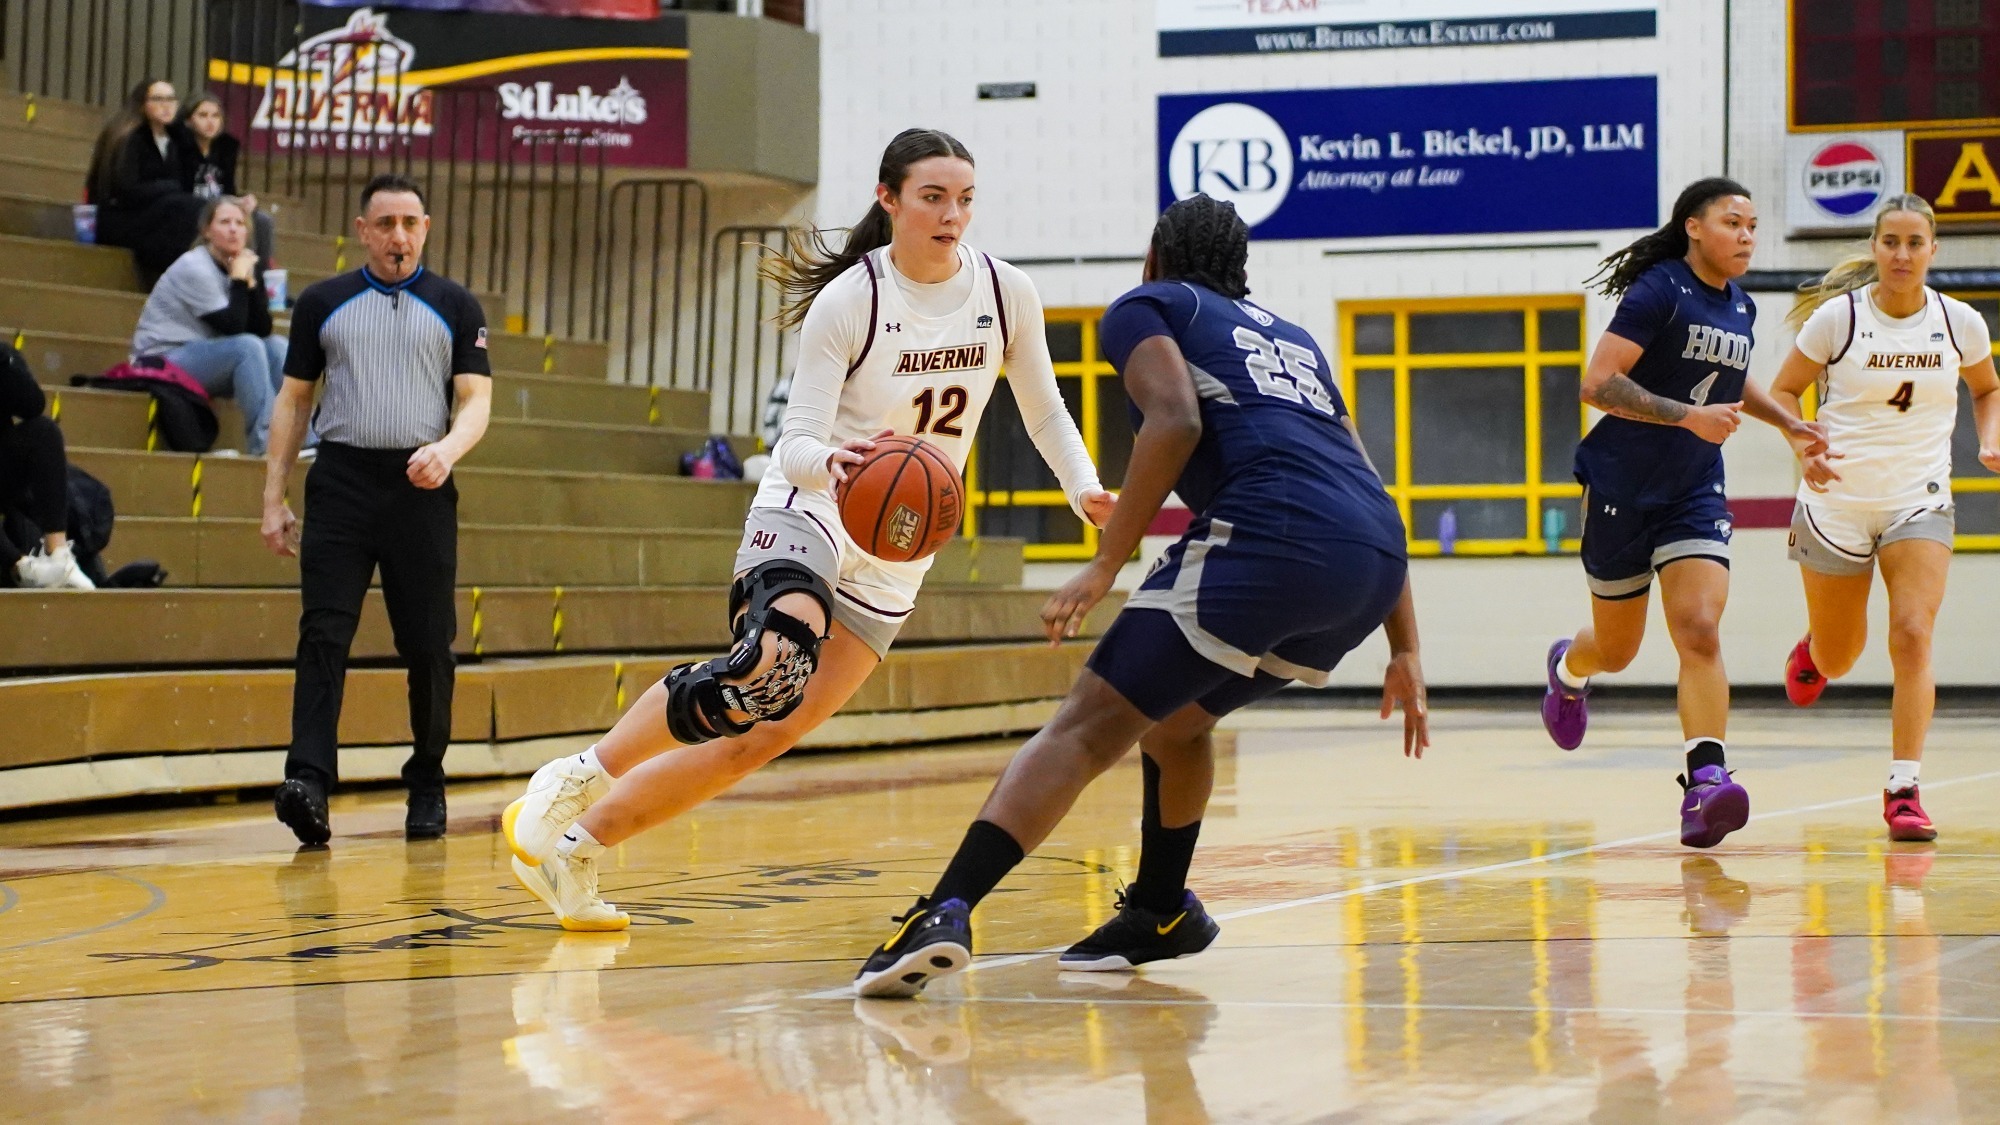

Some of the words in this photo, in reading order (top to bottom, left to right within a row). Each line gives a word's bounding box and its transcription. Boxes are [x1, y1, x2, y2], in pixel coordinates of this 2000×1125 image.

[1299, 132, 1380, 162] Kevin
[1388, 131, 1415, 159] L.
[1424, 126, 1520, 158] Bickel,
[1524, 126, 1574, 160] JD,
[1583, 123, 1644, 152] LLM
[1186, 138, 1279, 194] KB
[1298, 168, 1386, 193] Attorney
[1391, 169, 1415, 188] at
[1418, 166, 1463, 187] Law
[1810, 170, 1881, 188] PEPSI
[1934, 142, 2000, 207] A
[897, 345, 984, 374] ALVERNIA
[1681, 324, 1751, 371] HOOD
[1866, 353, 1942, 369] ALVERNIA
[1232, 325, 1336, 417] 25
[911, 385, 969, 438] 12
[1887, 380, 1915, 413] 4
[749, 528, 779, 551] AU
[896, 511, 918, 551] MAC
